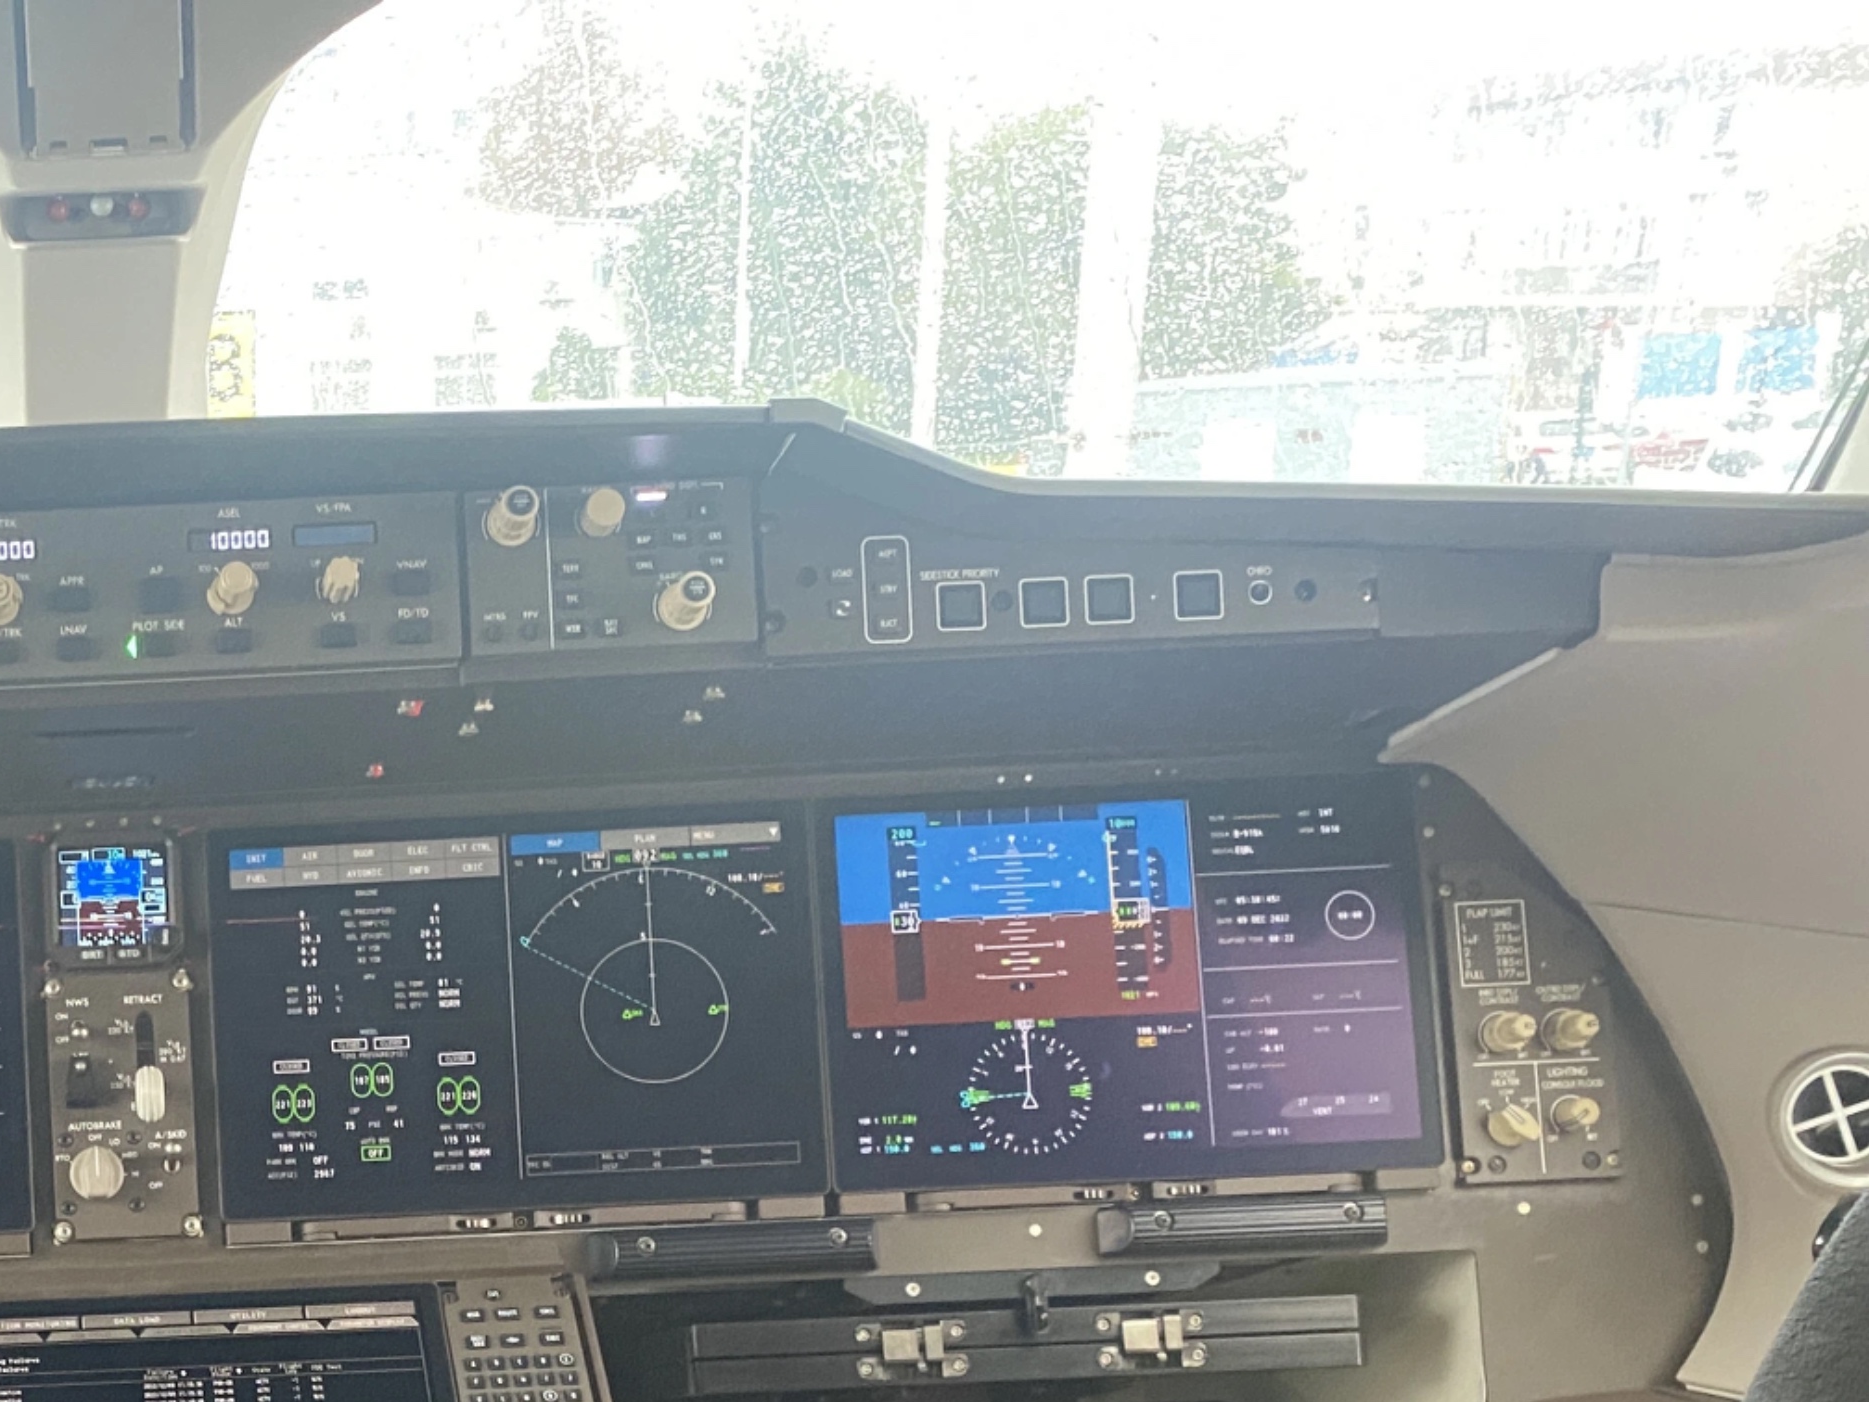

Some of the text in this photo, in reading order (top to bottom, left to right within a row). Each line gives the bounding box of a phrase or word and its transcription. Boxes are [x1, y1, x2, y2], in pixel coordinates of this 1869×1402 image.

[217, 508, 241, 519] ASEL
[210, 529, 269, 550] 10000
[396, 560, 427, 569] VNAV
[920, 568, 1000, 580] SIDESTICK PRIORITY
[59, 576, 84, 586] APPR
[331, 611, 346, 622] VS
[398, 607, 428, 618] FD/TD
[132, 621, 158, 631] PILOT
[224, 617, 243, 628] ALT
[60, 625, 87, 635] LNAV
[635, 834, 656, 843] PLAN
[891, 829, 913, 840] 200
[547, 839, 562, 847] MAP
[1467, 907, 1512, 918] FLAP LIMIT
[1465, 970, 1484, 980] FULL
[66, 998, 89, 1007] NWS
[123, 994, 162, 1004] RETRACT
[55, 1036, 69, 1044] OFF
[1547, 1067, 1587, 1077] LIGHTING
[68, 1120, 122, 1131] AUTOBRAKE
[155, 1129, 187, 1139] A/SKID
[148, 1181, 163, 1189] OFF
[231, 1311, 267, 1321] UTILITY
